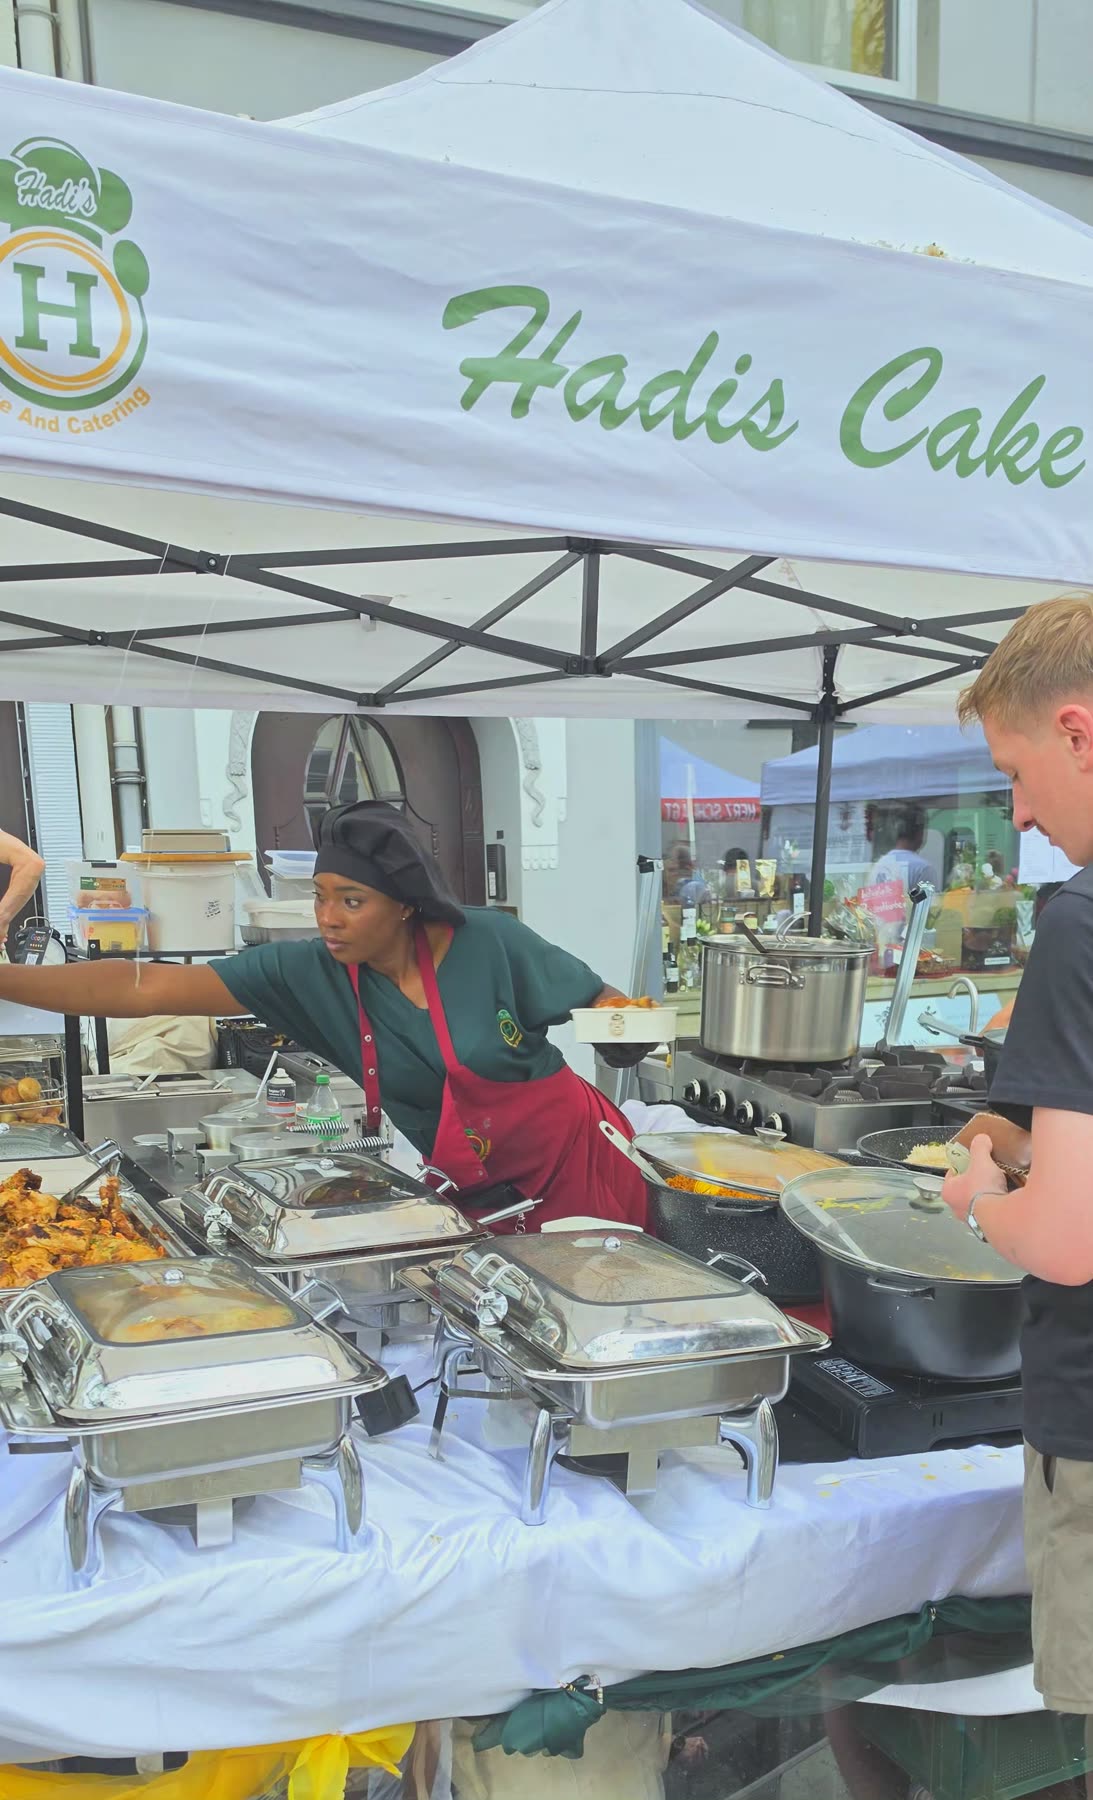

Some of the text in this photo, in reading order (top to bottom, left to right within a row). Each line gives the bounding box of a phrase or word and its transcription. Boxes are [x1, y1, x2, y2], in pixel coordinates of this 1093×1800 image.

[15, 168, 97, 216] Hadi's
[13, 262, 100, 359] H
[18, 385, 151, 434] And Catering
[442, 285, 1086, 488] Hadis Cake
